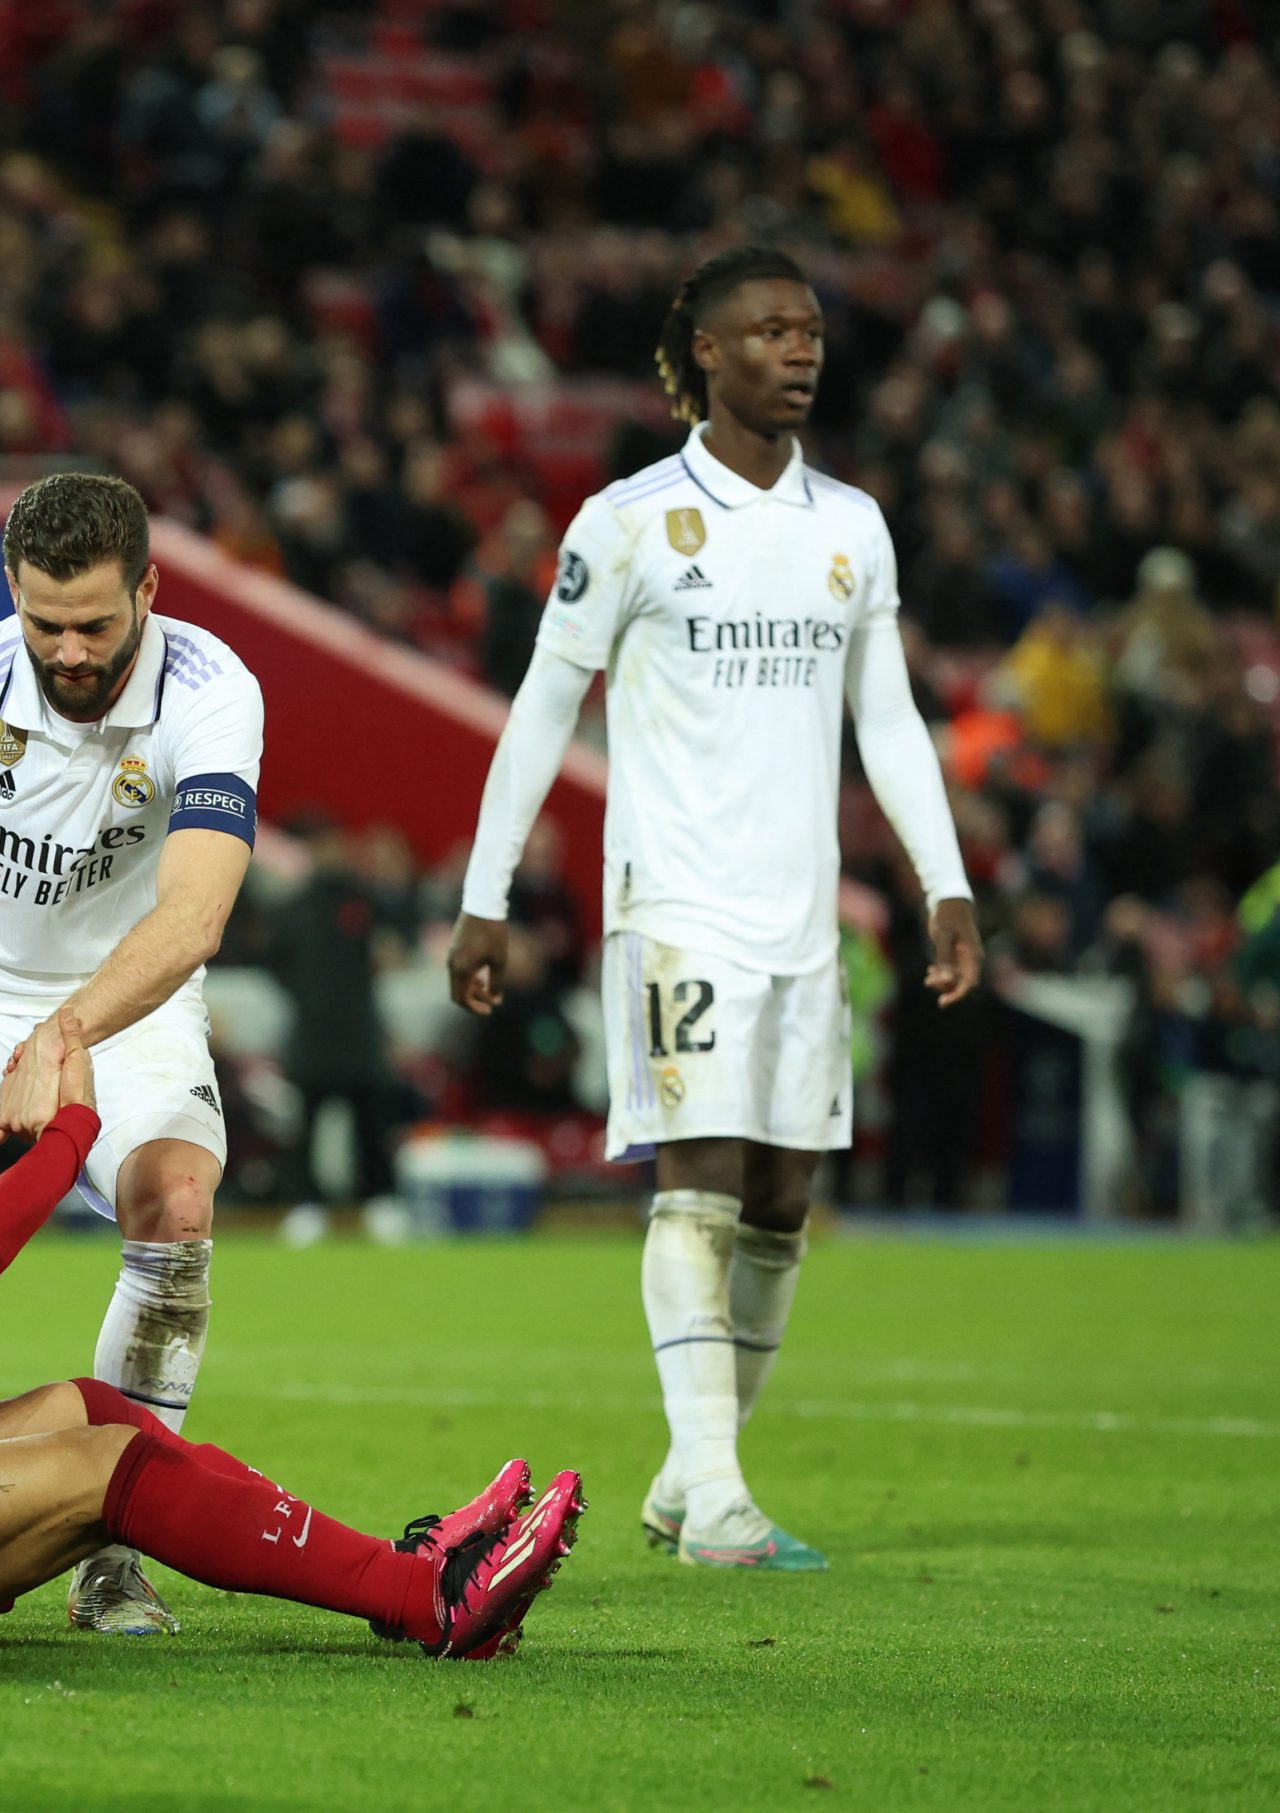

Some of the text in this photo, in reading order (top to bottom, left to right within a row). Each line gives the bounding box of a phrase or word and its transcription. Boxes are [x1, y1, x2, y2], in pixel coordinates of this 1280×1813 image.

[686, 611, 846, 652] Emirates
[713, 656, 818, 688] FLY BETTE
[185, 792, 246, 814] RESPECT
[646, 979, 716, 1058] 12
